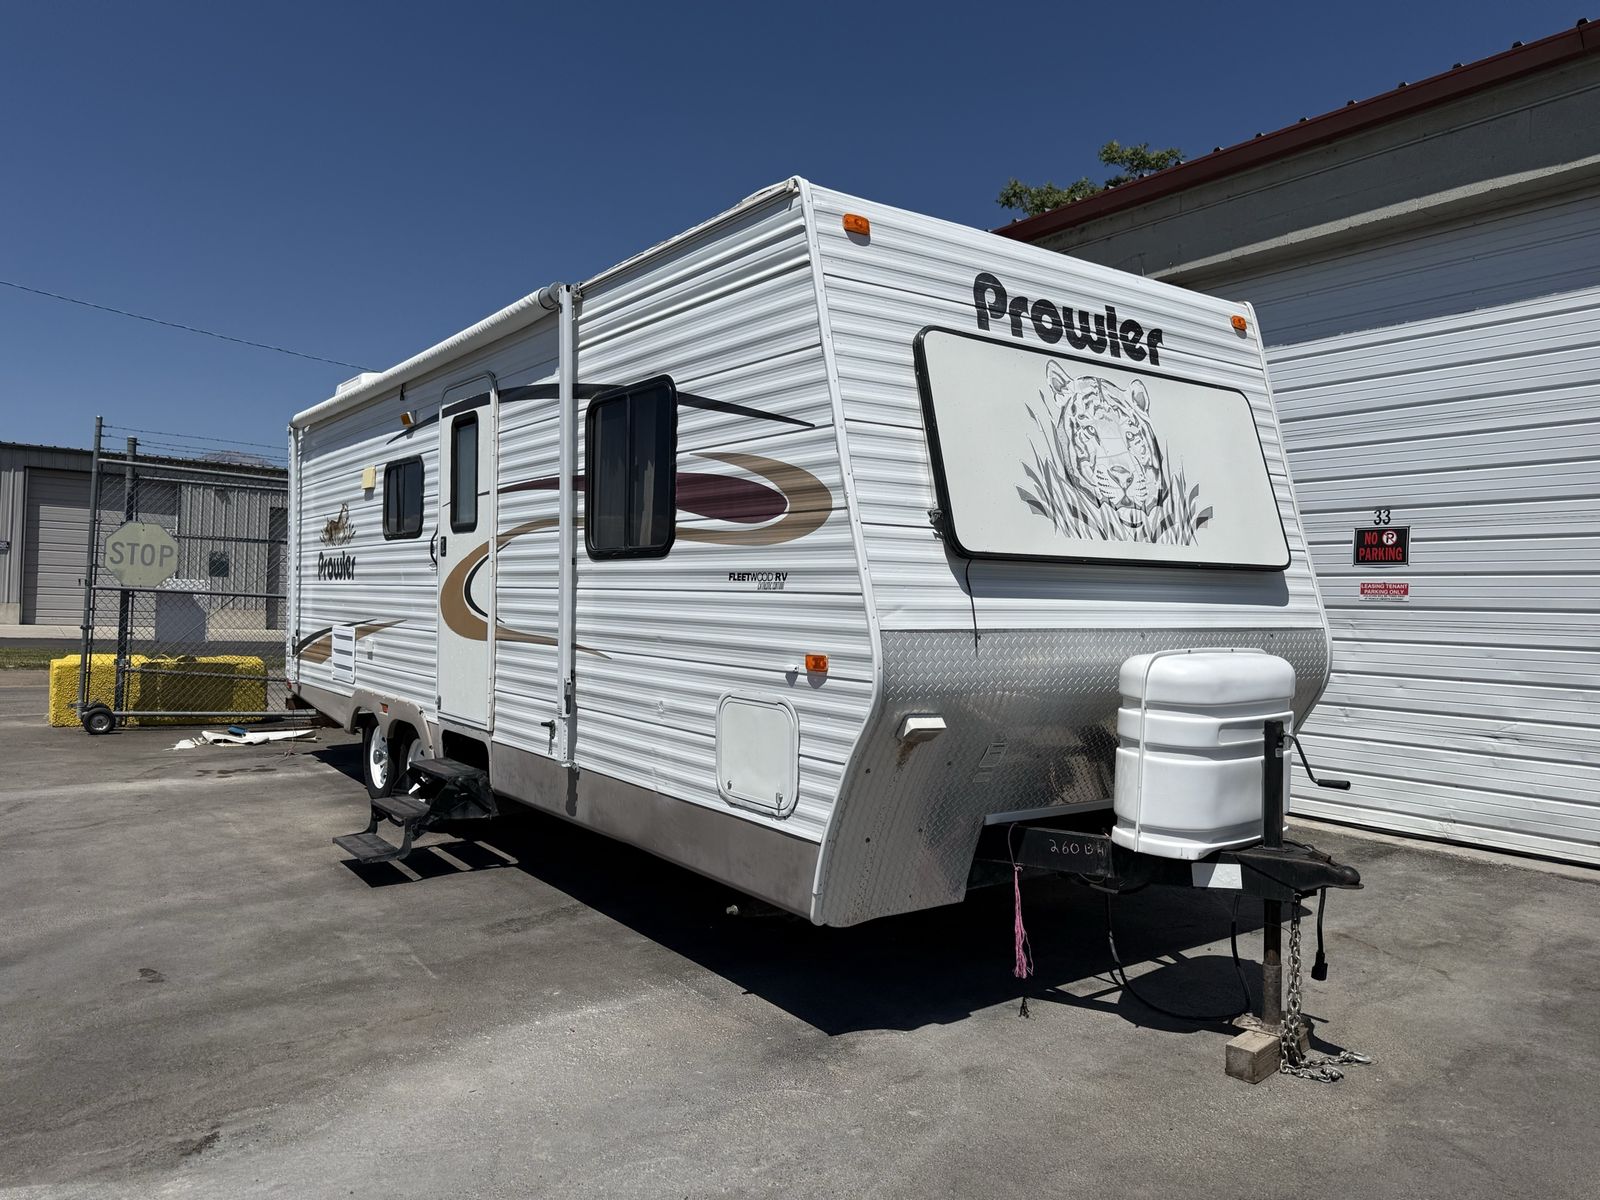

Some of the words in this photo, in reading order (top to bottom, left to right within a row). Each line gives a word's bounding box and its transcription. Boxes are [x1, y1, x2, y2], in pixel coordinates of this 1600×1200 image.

[973, 272, 1164, 366] Prowler
[1373, 509, 1391, 525] 33
[1364, 531, 1378, 545] NO
[109, 541, 174, 567] STOP
[1359, 546, 1403, 561] PARKING
[318, 550, 356, 581] Prowler
[728, 572, 773, 582] FLEETWOOD
[775, 572, 788, 582] RV
